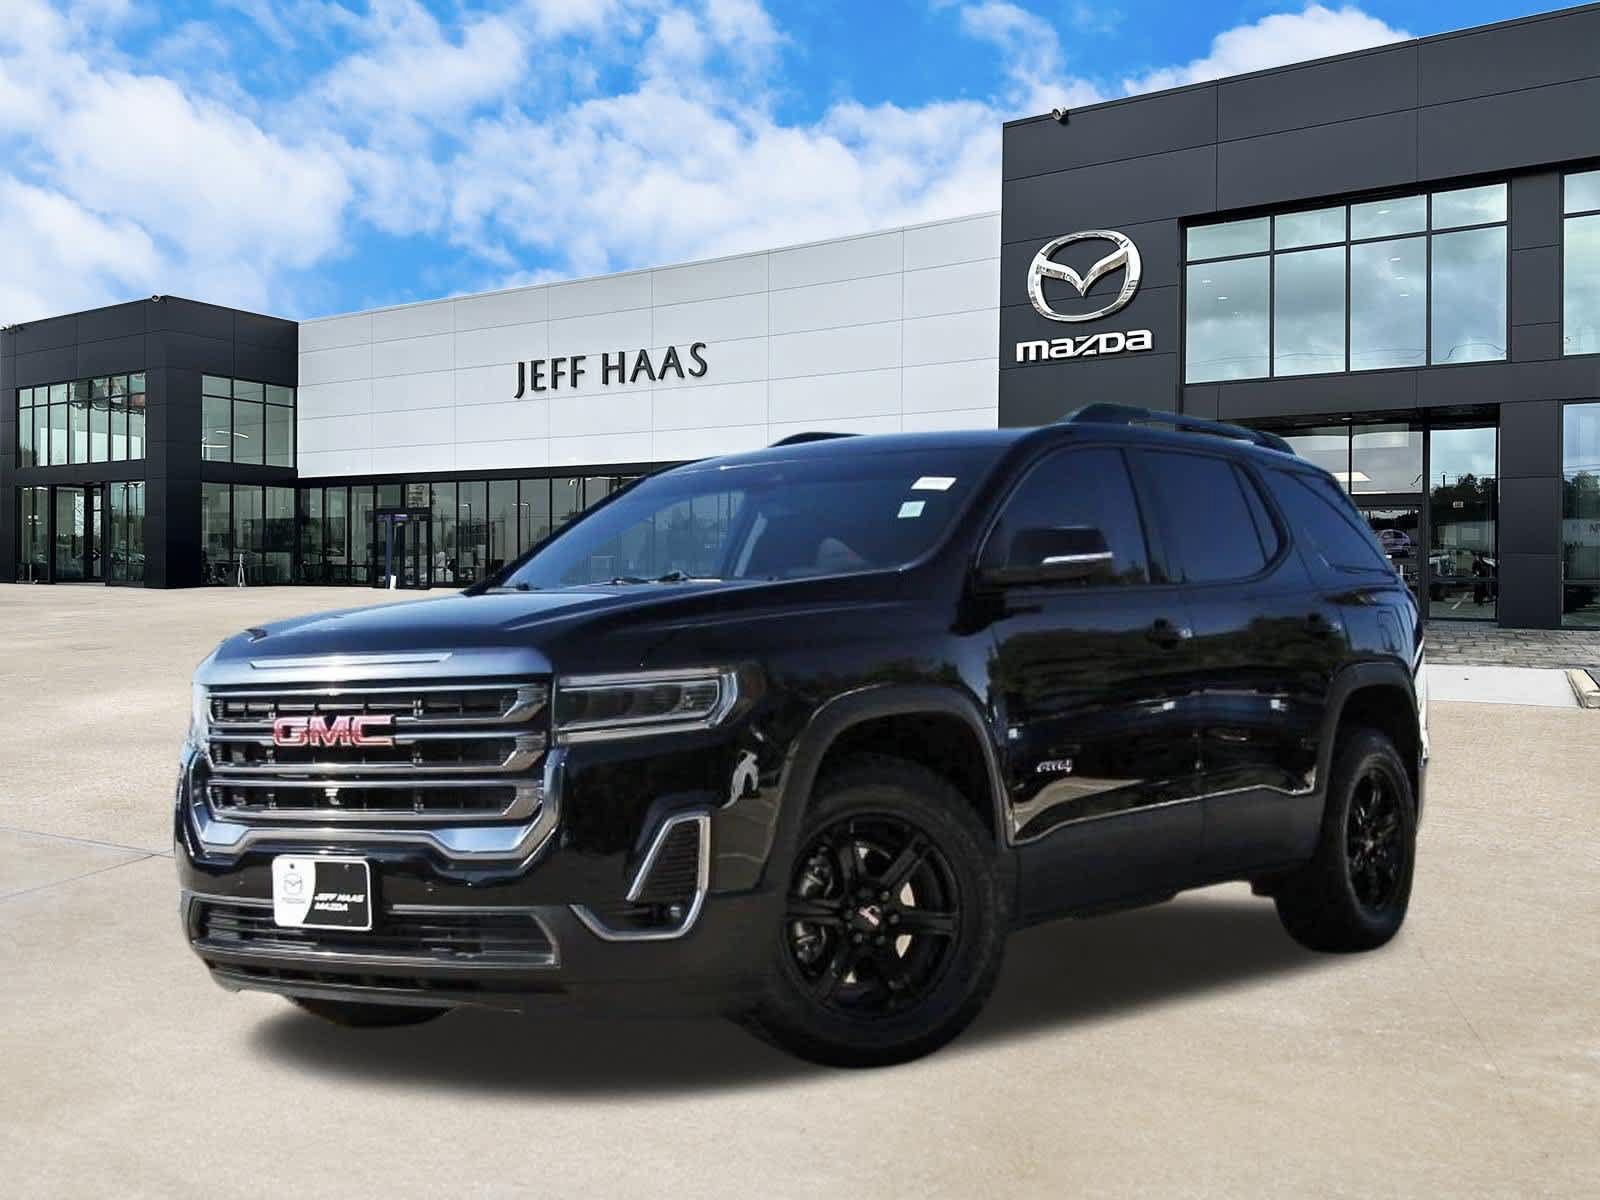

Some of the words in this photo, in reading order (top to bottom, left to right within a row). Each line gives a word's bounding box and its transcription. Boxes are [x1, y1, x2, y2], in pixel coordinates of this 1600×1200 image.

[513, 355, 587, 399] JEFF
[601, 342, 708, 386] HAAS
[272, 714, 394, 747] GMC
[314, 893, 338, 902] JEFF
[337, 894, 365, 903] HAAS
[314, 902, 348, 911] MAZDA
